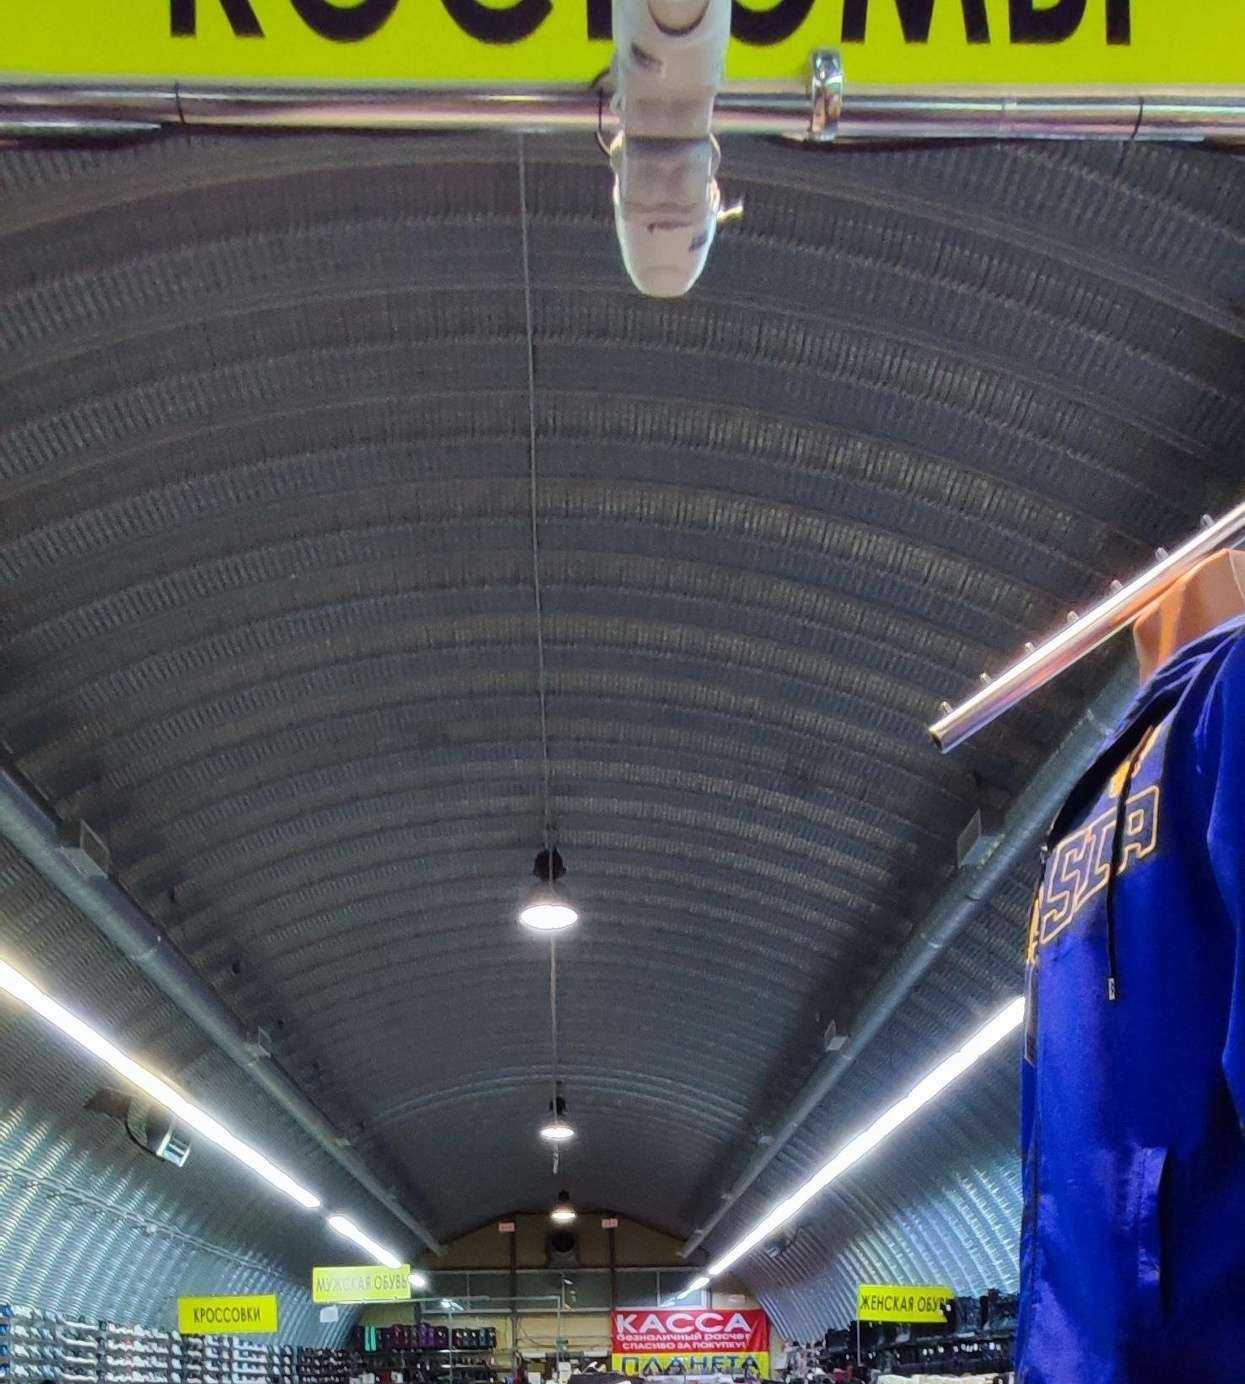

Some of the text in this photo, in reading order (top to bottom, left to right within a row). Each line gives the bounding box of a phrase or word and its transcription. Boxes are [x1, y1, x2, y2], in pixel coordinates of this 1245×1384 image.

[860, 1295, 914, 1312] ЖЕНСКАЯ
[193, 1306, 261, 1323] КРОССОВКИ
[615, 1312, 752, 1334] КАССА
[622, 1342, 676, 1350] СПАСИБО
[677, 1342, 692, 1350] ЗА
[621, 1354, 762, 1377] ПЛАНЕТА
